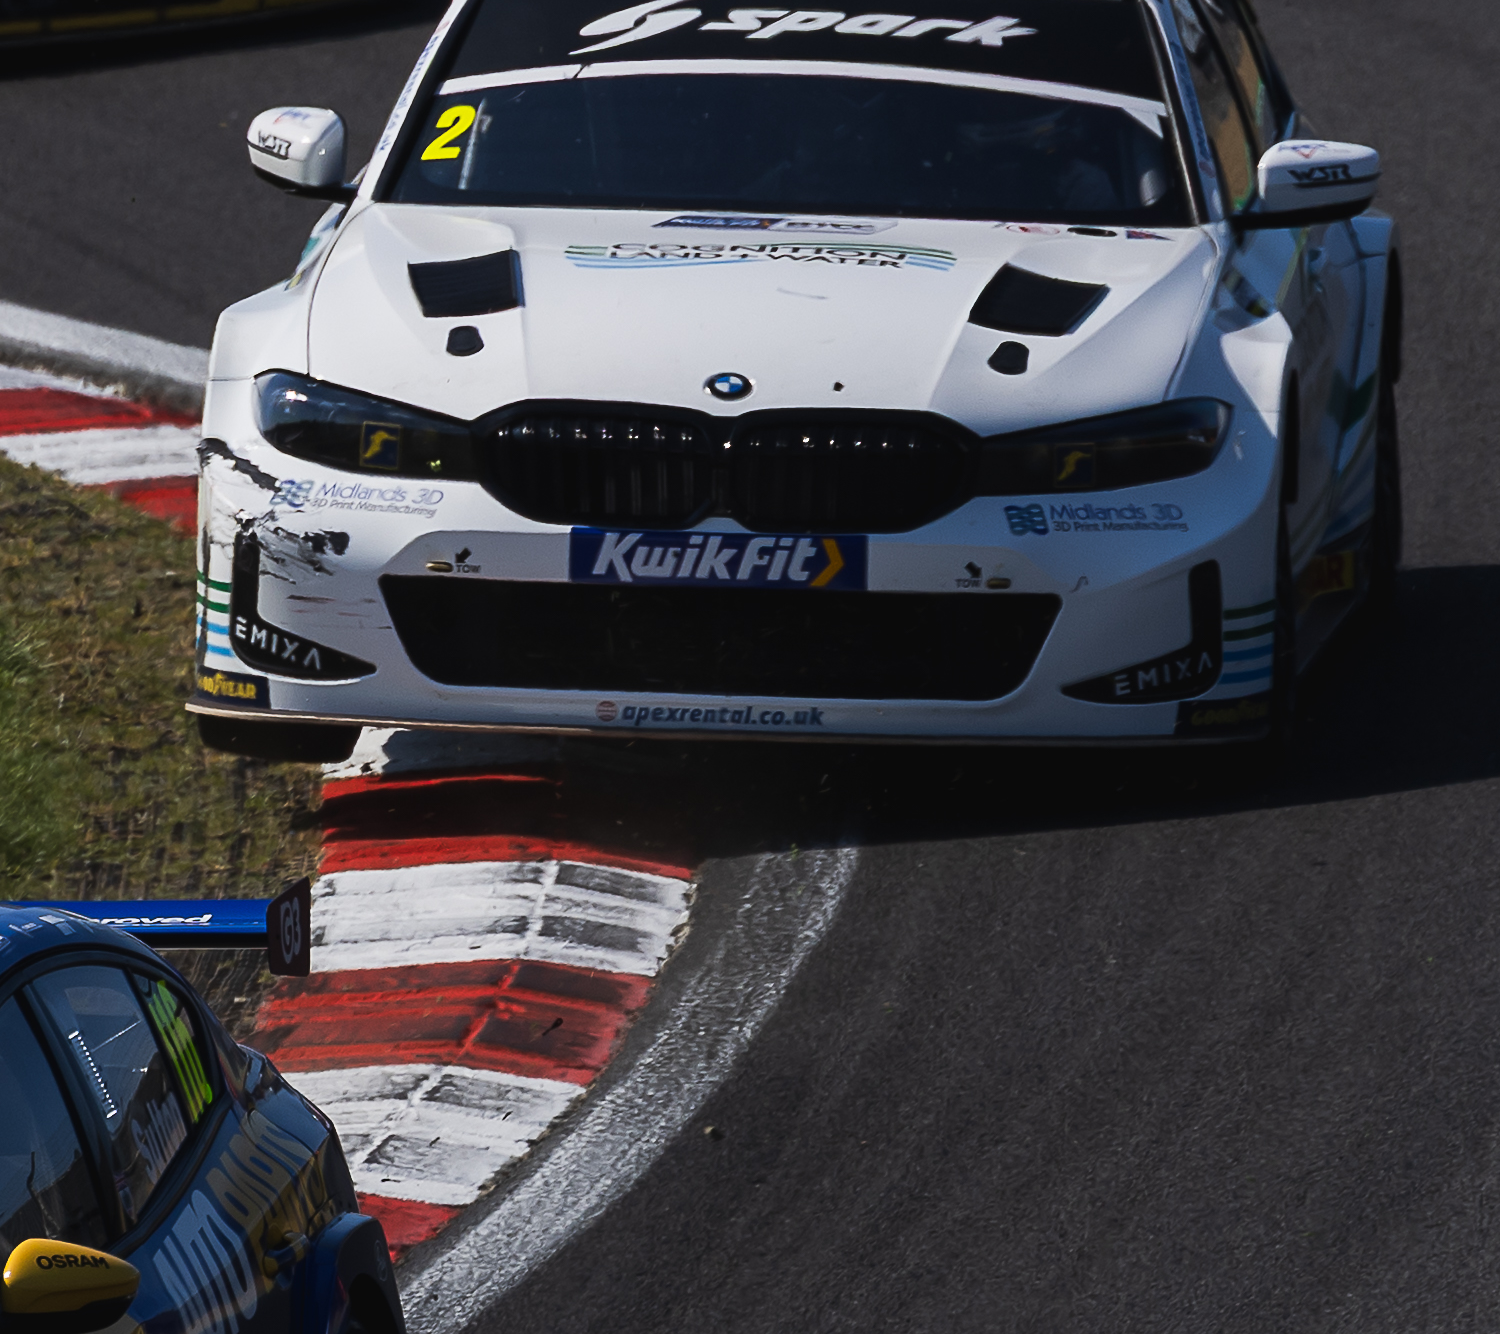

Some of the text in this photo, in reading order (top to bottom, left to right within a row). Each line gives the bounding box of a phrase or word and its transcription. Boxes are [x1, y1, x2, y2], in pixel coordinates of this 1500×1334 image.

[700, 8, 1039, 48] spark
[420, 105, 476, 161] 2
[611, 243, 907, 261] COGNITION
[316, 482, 445, 506] Midlands 3D
[1049, 503, 1184, 522] Midlands 3D
[621, 703, 824, 728] apexrental.co.uk
[35, 1254, 110, 1270] OSRAM
